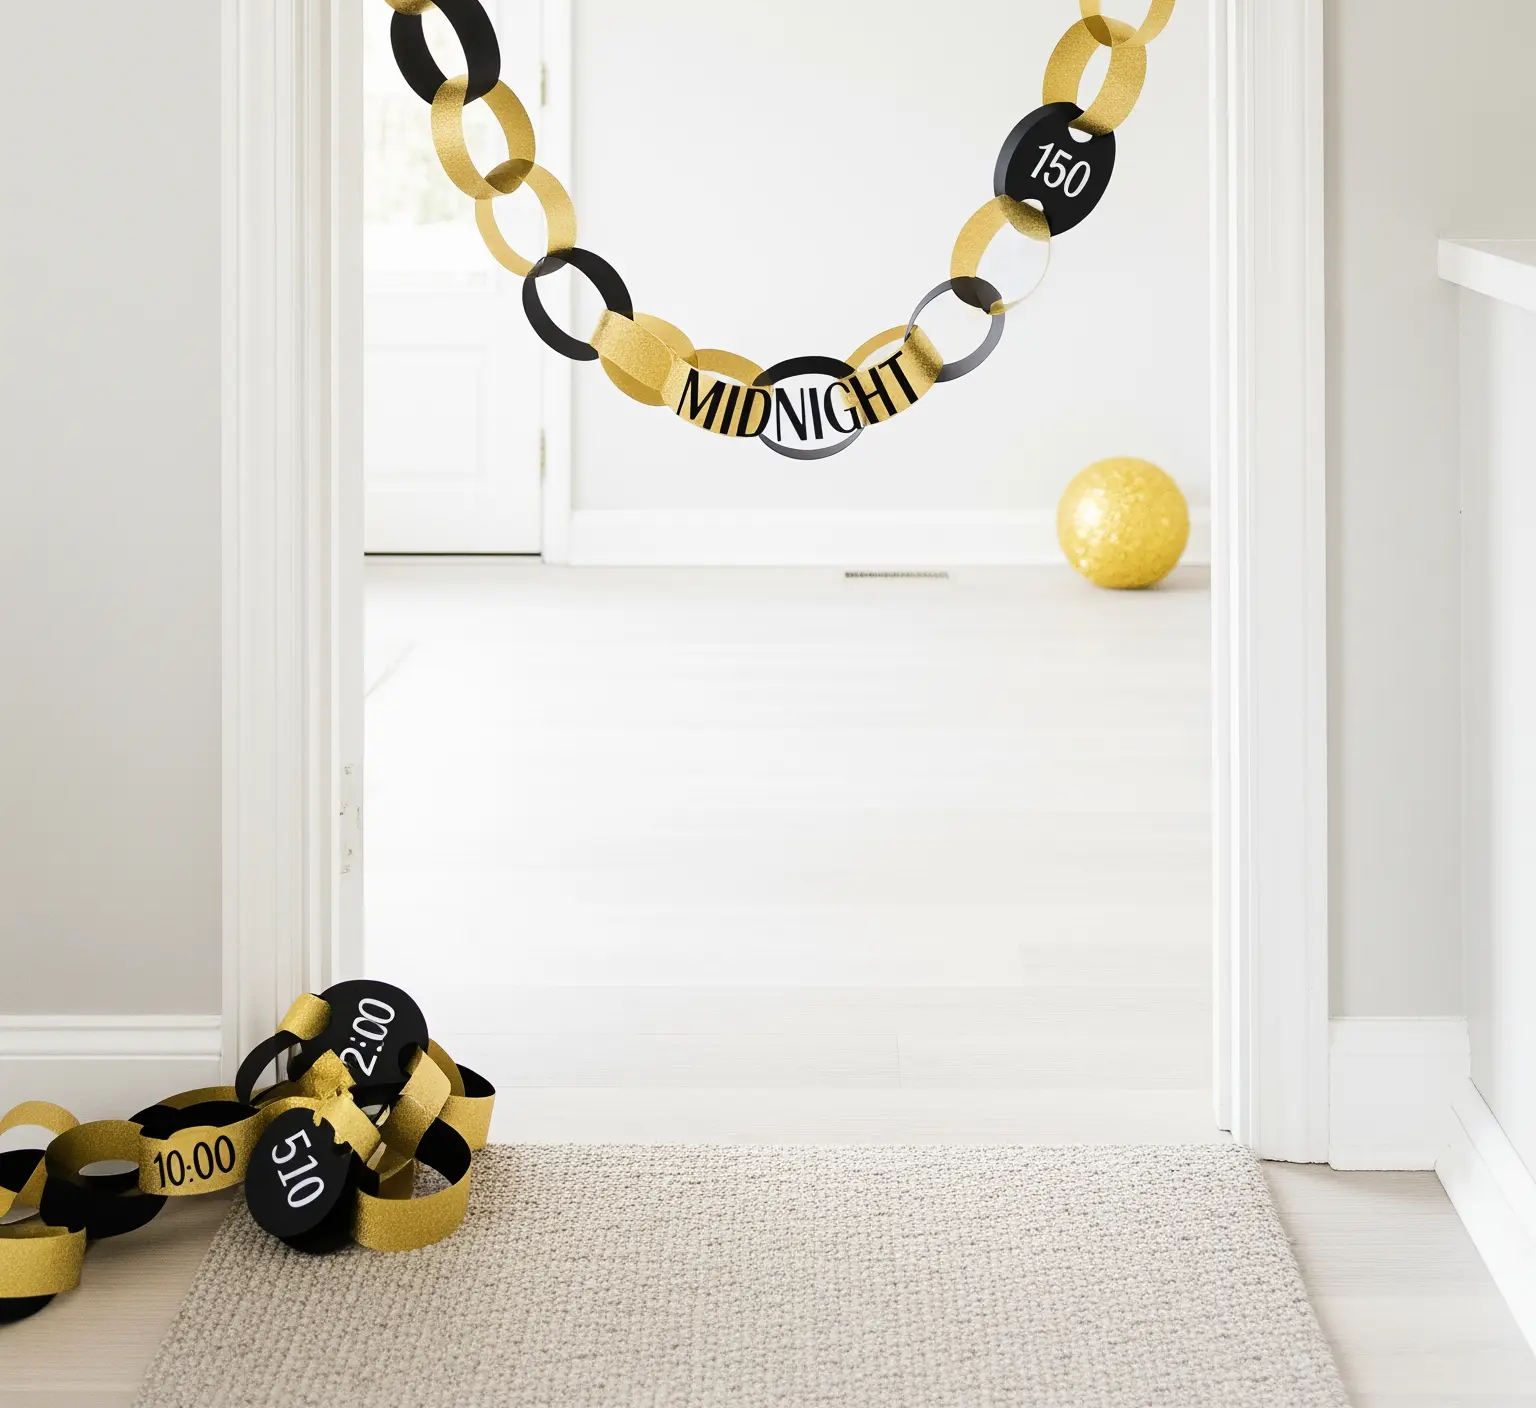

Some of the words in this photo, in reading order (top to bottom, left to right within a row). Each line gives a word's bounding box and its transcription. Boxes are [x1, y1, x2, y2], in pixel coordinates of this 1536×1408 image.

[1030, 142, 1091, 198] 150
[676, 350, 919, 442] MIDNIGHT
[339, 997, 396, 1077] 2:00
[153, 1135, 236, 1188] 10:00
[271, 1129, 325, 1208] 510
